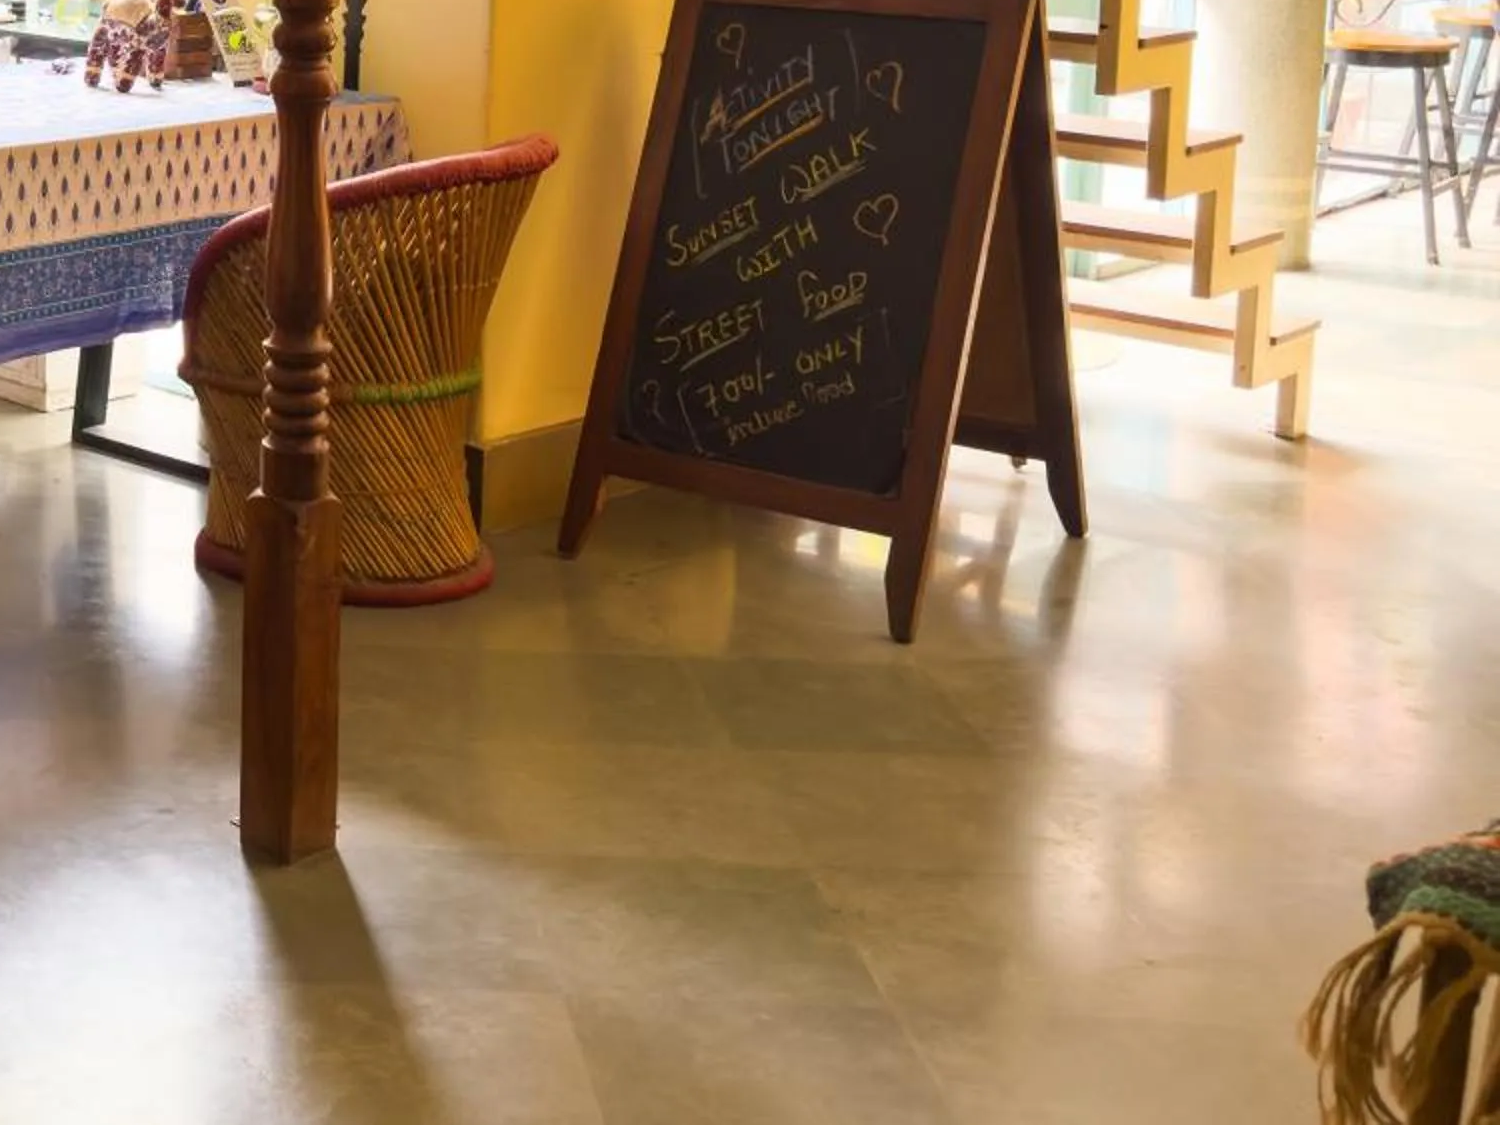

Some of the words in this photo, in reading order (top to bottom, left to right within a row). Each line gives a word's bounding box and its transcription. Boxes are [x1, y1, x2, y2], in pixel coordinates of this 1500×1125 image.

[780, 127, 877, 204] WALK
[736, 214, 818, 282] WITH
[654, 299, 765, 364] STREET
[796, 325, 863, 374] ONLY
